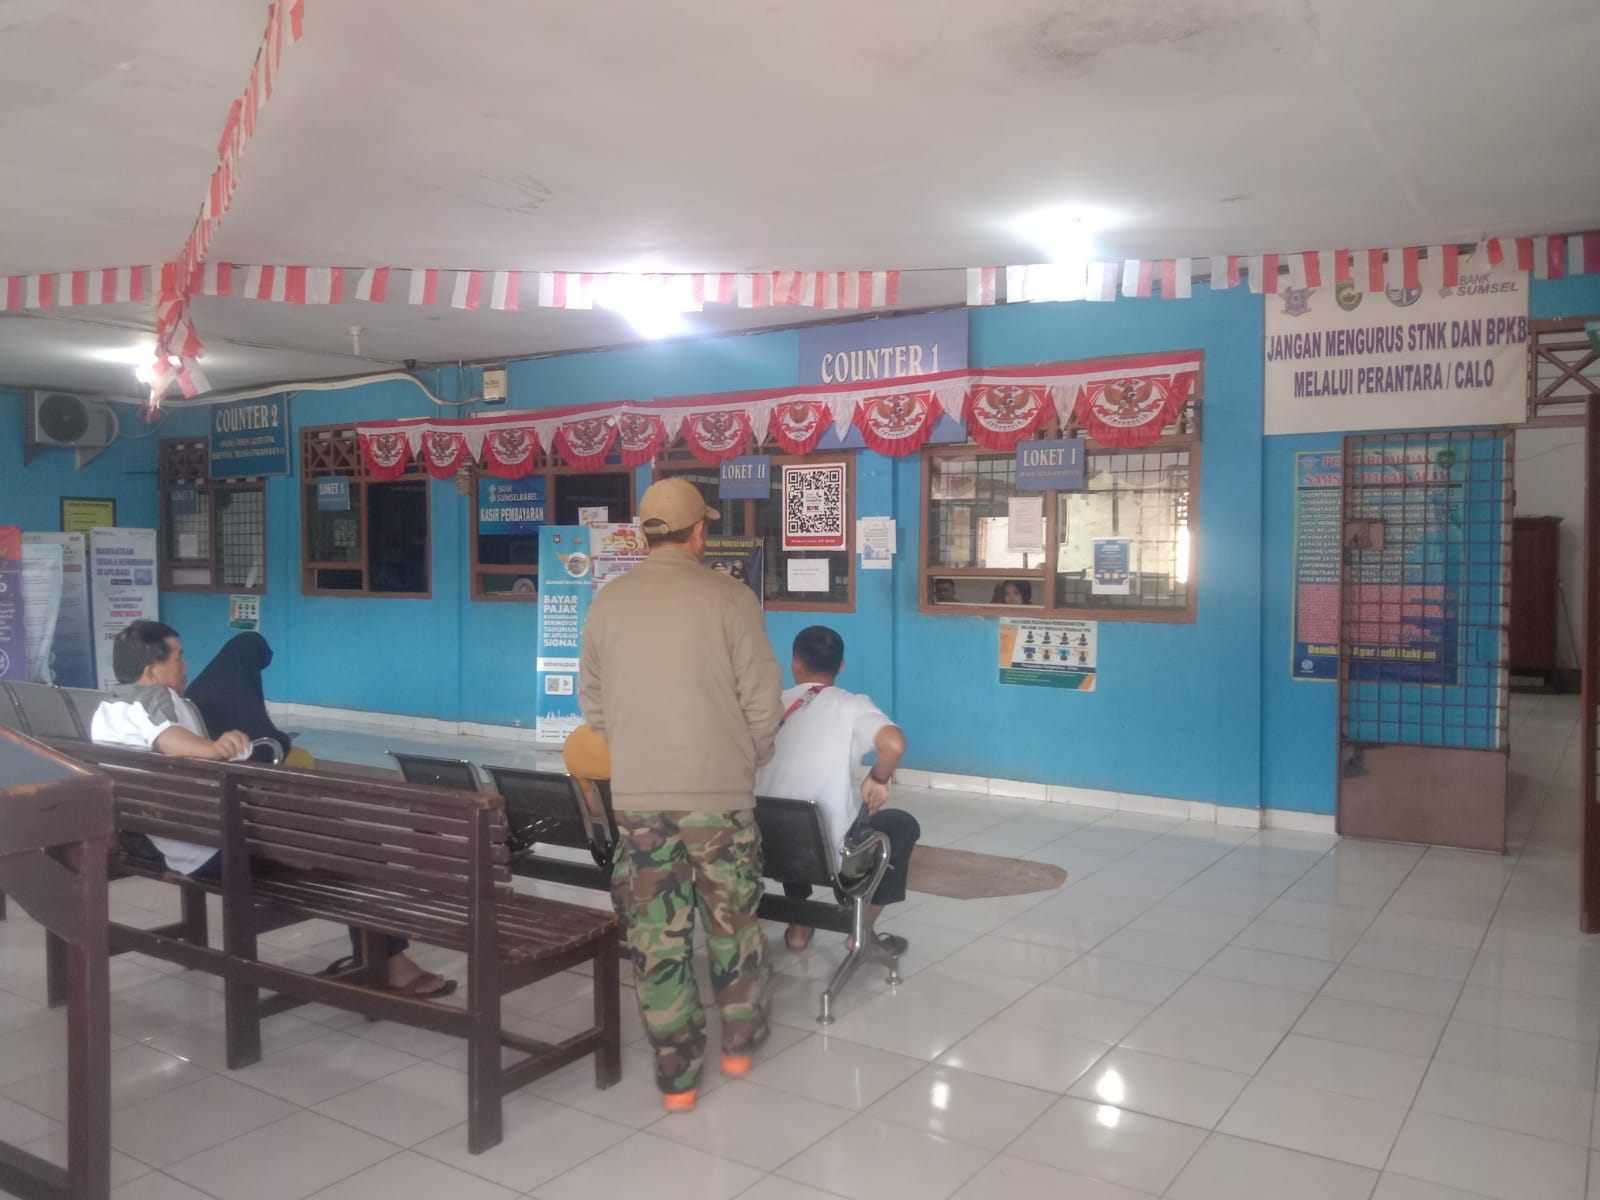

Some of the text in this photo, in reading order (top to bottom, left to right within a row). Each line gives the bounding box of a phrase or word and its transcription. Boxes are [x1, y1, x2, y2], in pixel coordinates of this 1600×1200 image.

[1459, 273, 1490, 286] BANK
[1456, 281, 1519, 297] SUMSEL
[1267, 315, 1528, 361] JANGAN MENGURUS STNK DAN BPKB
[821, 343, 939, 384] COUNTER 1
[1293, 369, 1354, 398] MELALUI
[1357, 362, 1443, 394] PERANTARA
[1454, 358, 1494, 389] CALO
[216, 403, 279, 433] COUNTER 2
[1023, 448, 1065, 467] LOKET
[722, 464, 753, 480] LOKET
[480, 507, 544, 522] KASIR PEMBAYARAN
[543, 595, 578, 604] BAYAR
[543, 604, 578, 613] PAJAK
[543, 639, 578, 647] SIGNAL
